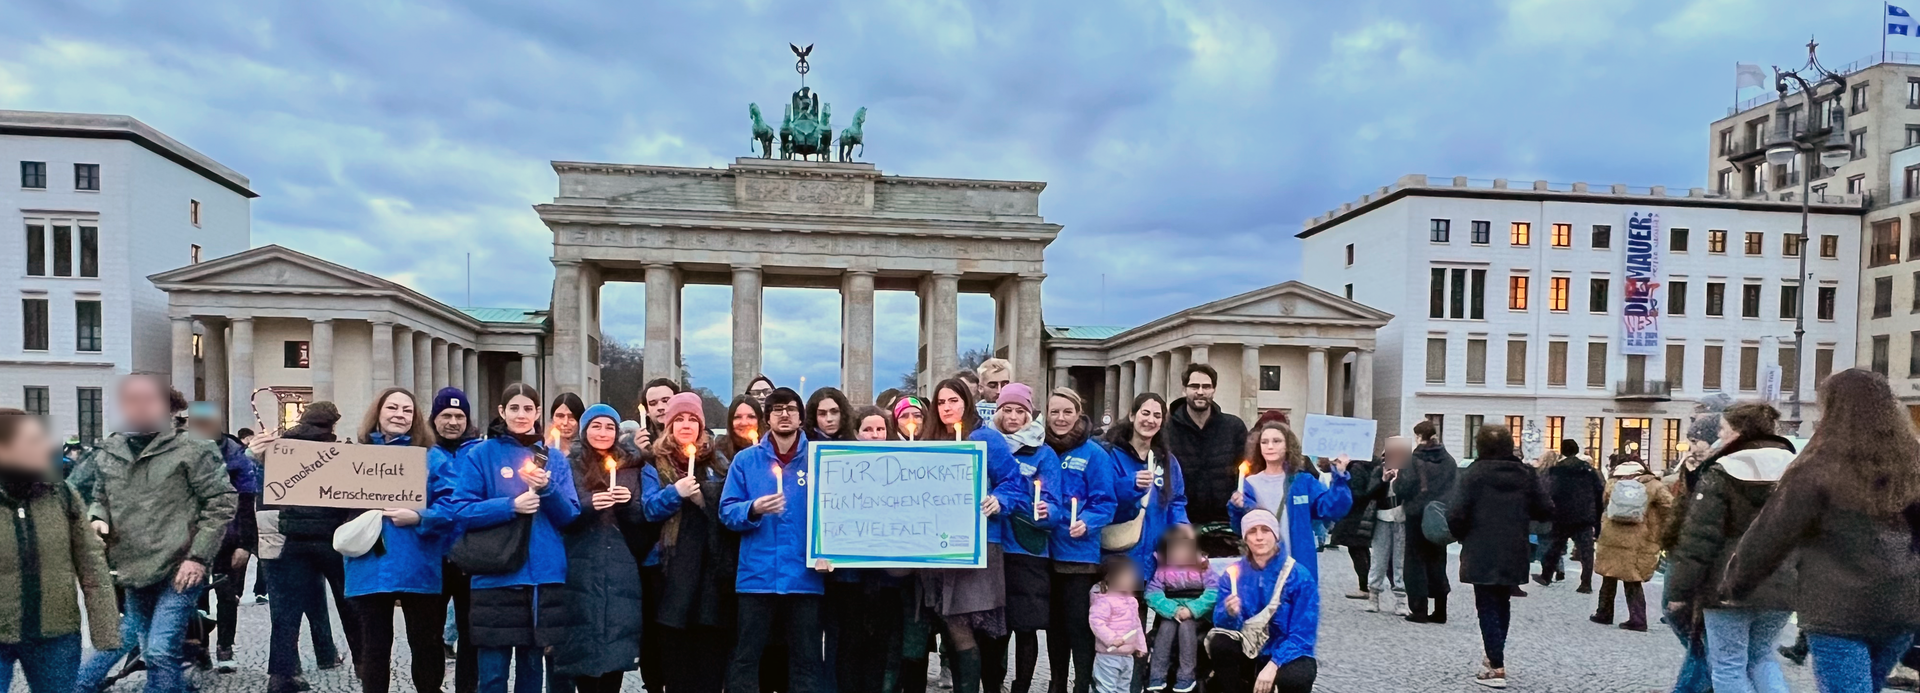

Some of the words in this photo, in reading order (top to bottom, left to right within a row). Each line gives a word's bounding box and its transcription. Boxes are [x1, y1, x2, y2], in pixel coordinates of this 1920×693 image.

[266, 446, 340, 501] Demokratie
[352, 461, 405, 479] Vielfalt
[319, 485, 423, 502] Menschenrechte
